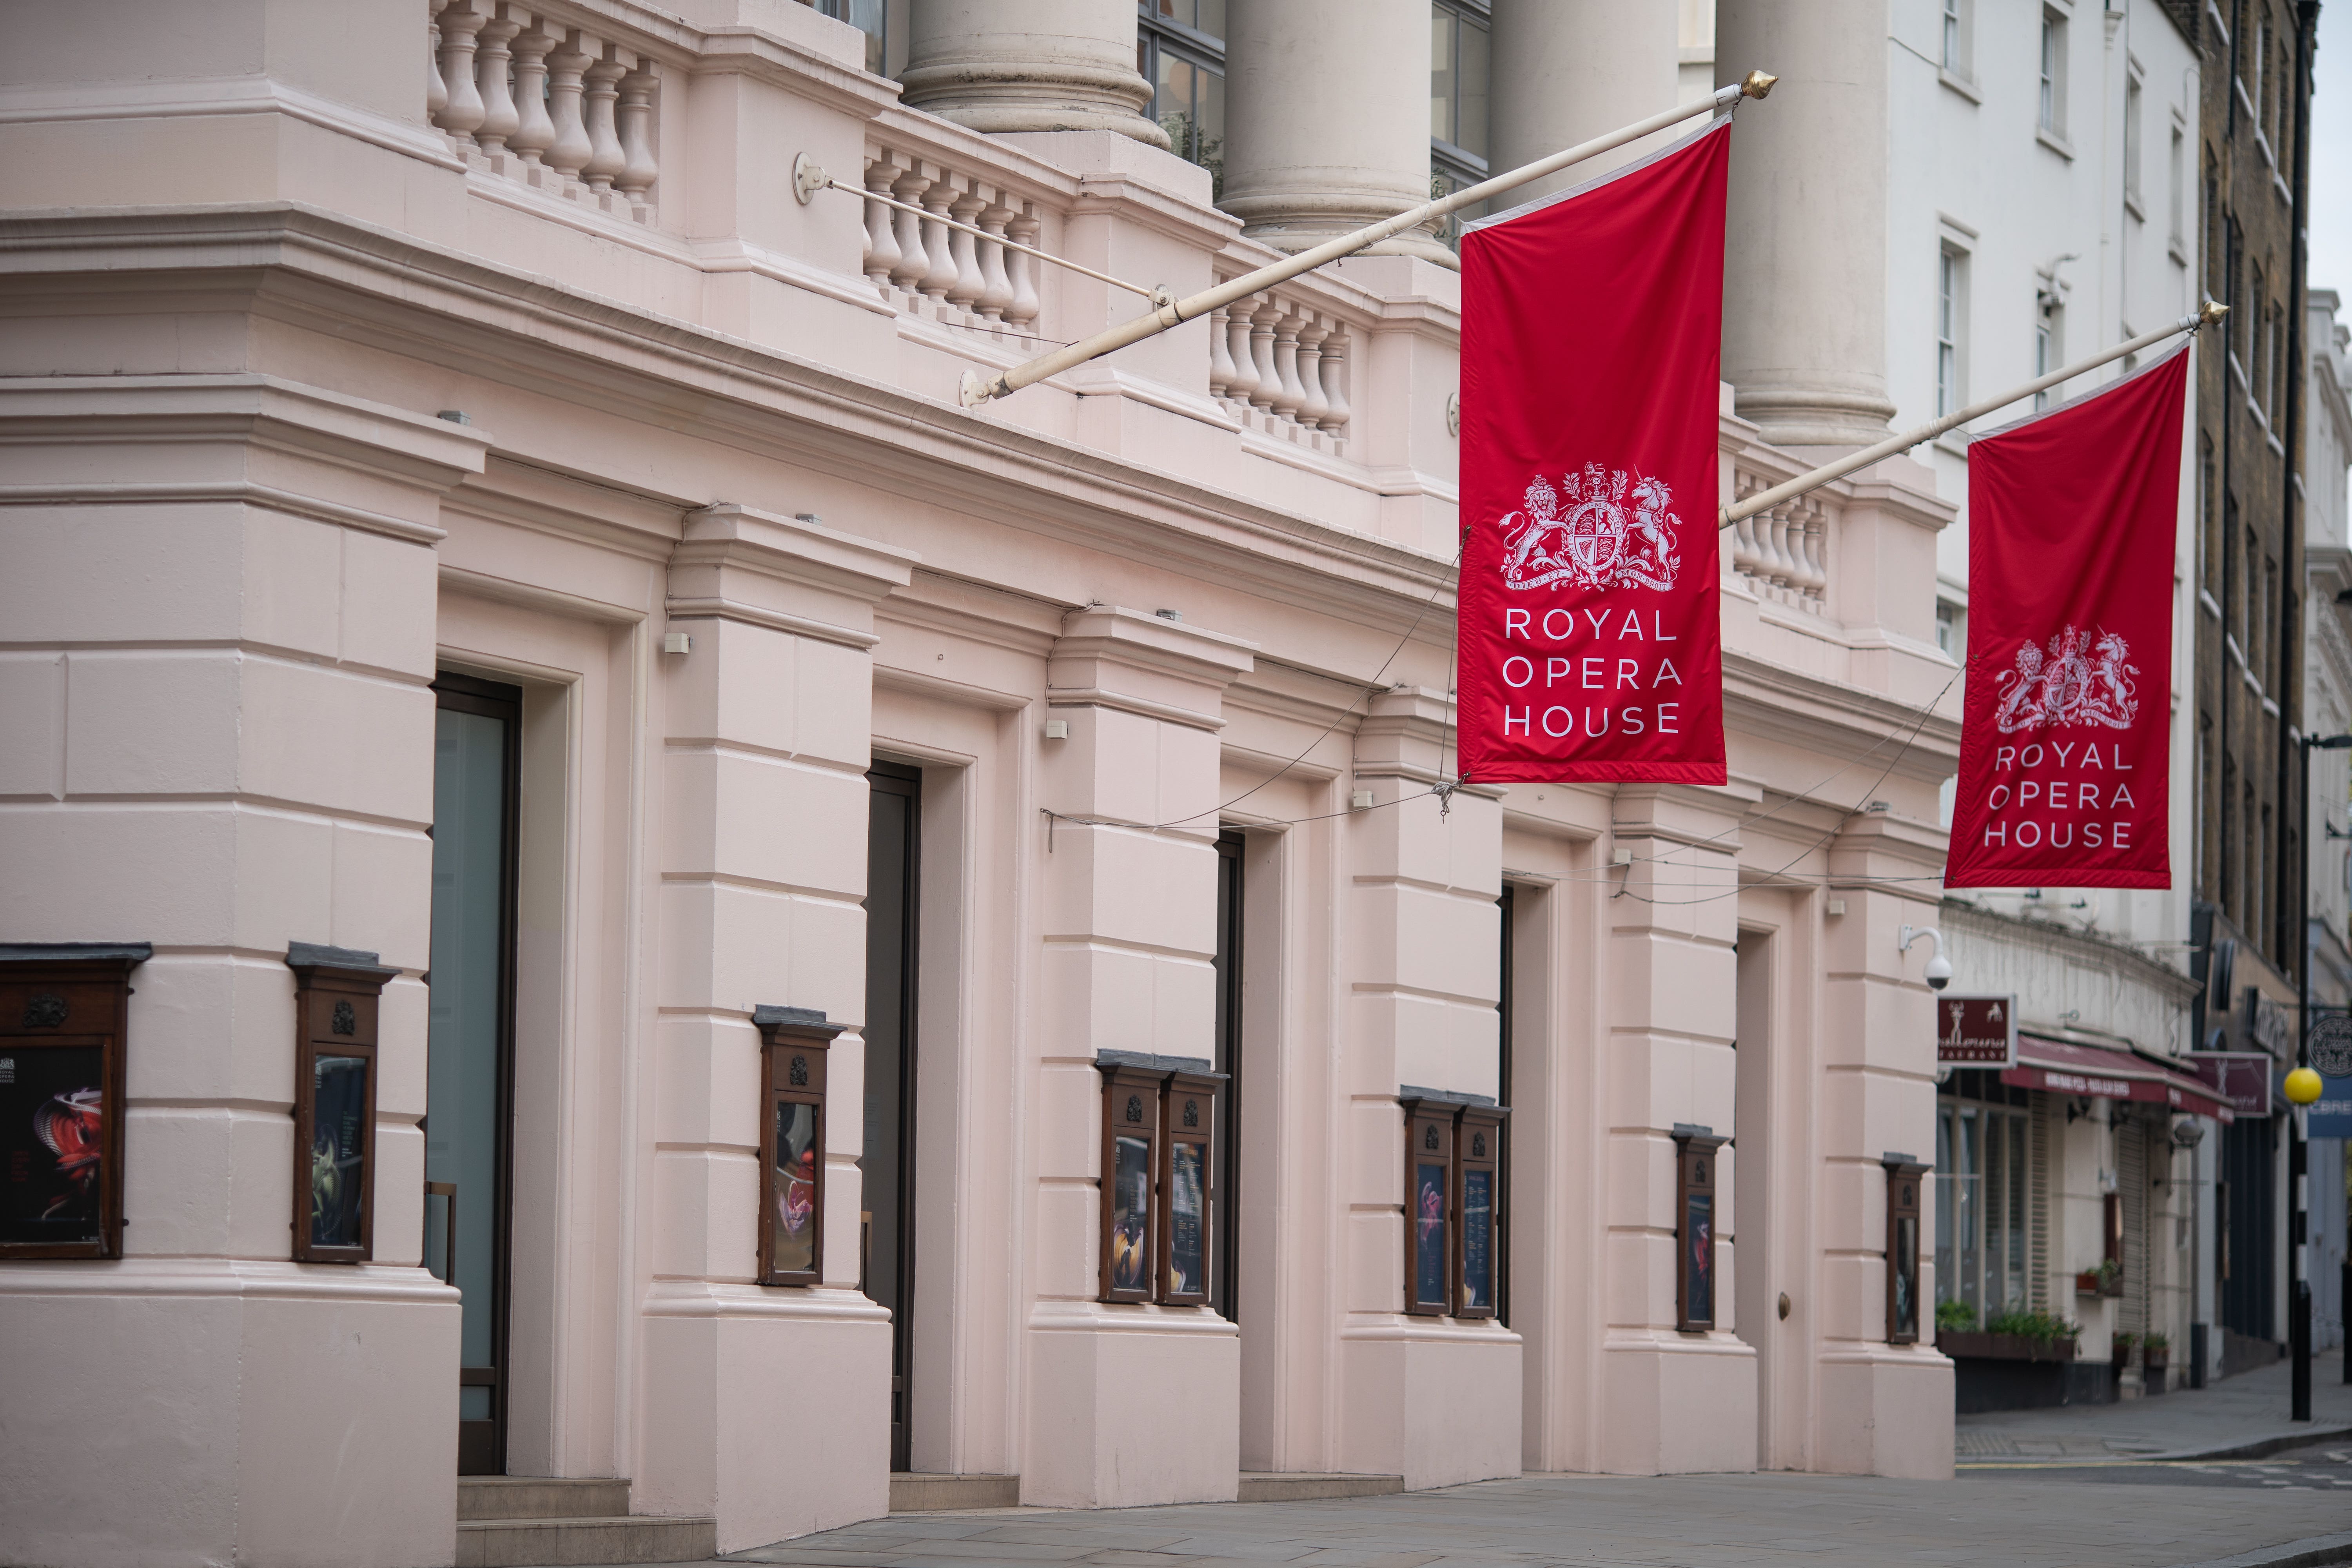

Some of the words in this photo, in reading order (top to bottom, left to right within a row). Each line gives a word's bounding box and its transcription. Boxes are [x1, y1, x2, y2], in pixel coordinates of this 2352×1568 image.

[1595, 503, 1613, 513] MAL
[1514, 579, 1542, 589] DIEU
[1548, 571, 1561, 580] ET
[1621, 570, 1642, 580] MON
[1645, 578, 1667, 590] DROIT
[1506, 608, 1677, 641] ROYAL
[1503, 656, 1682, 690] OPERA
[1505, 703, 1679, 737] HOUSE
[1995, 741, 2132, 771] ROYAL
[1989, 781, 2135, 810] OPERA
[1984, 821, 2131, 848] HOUSE
